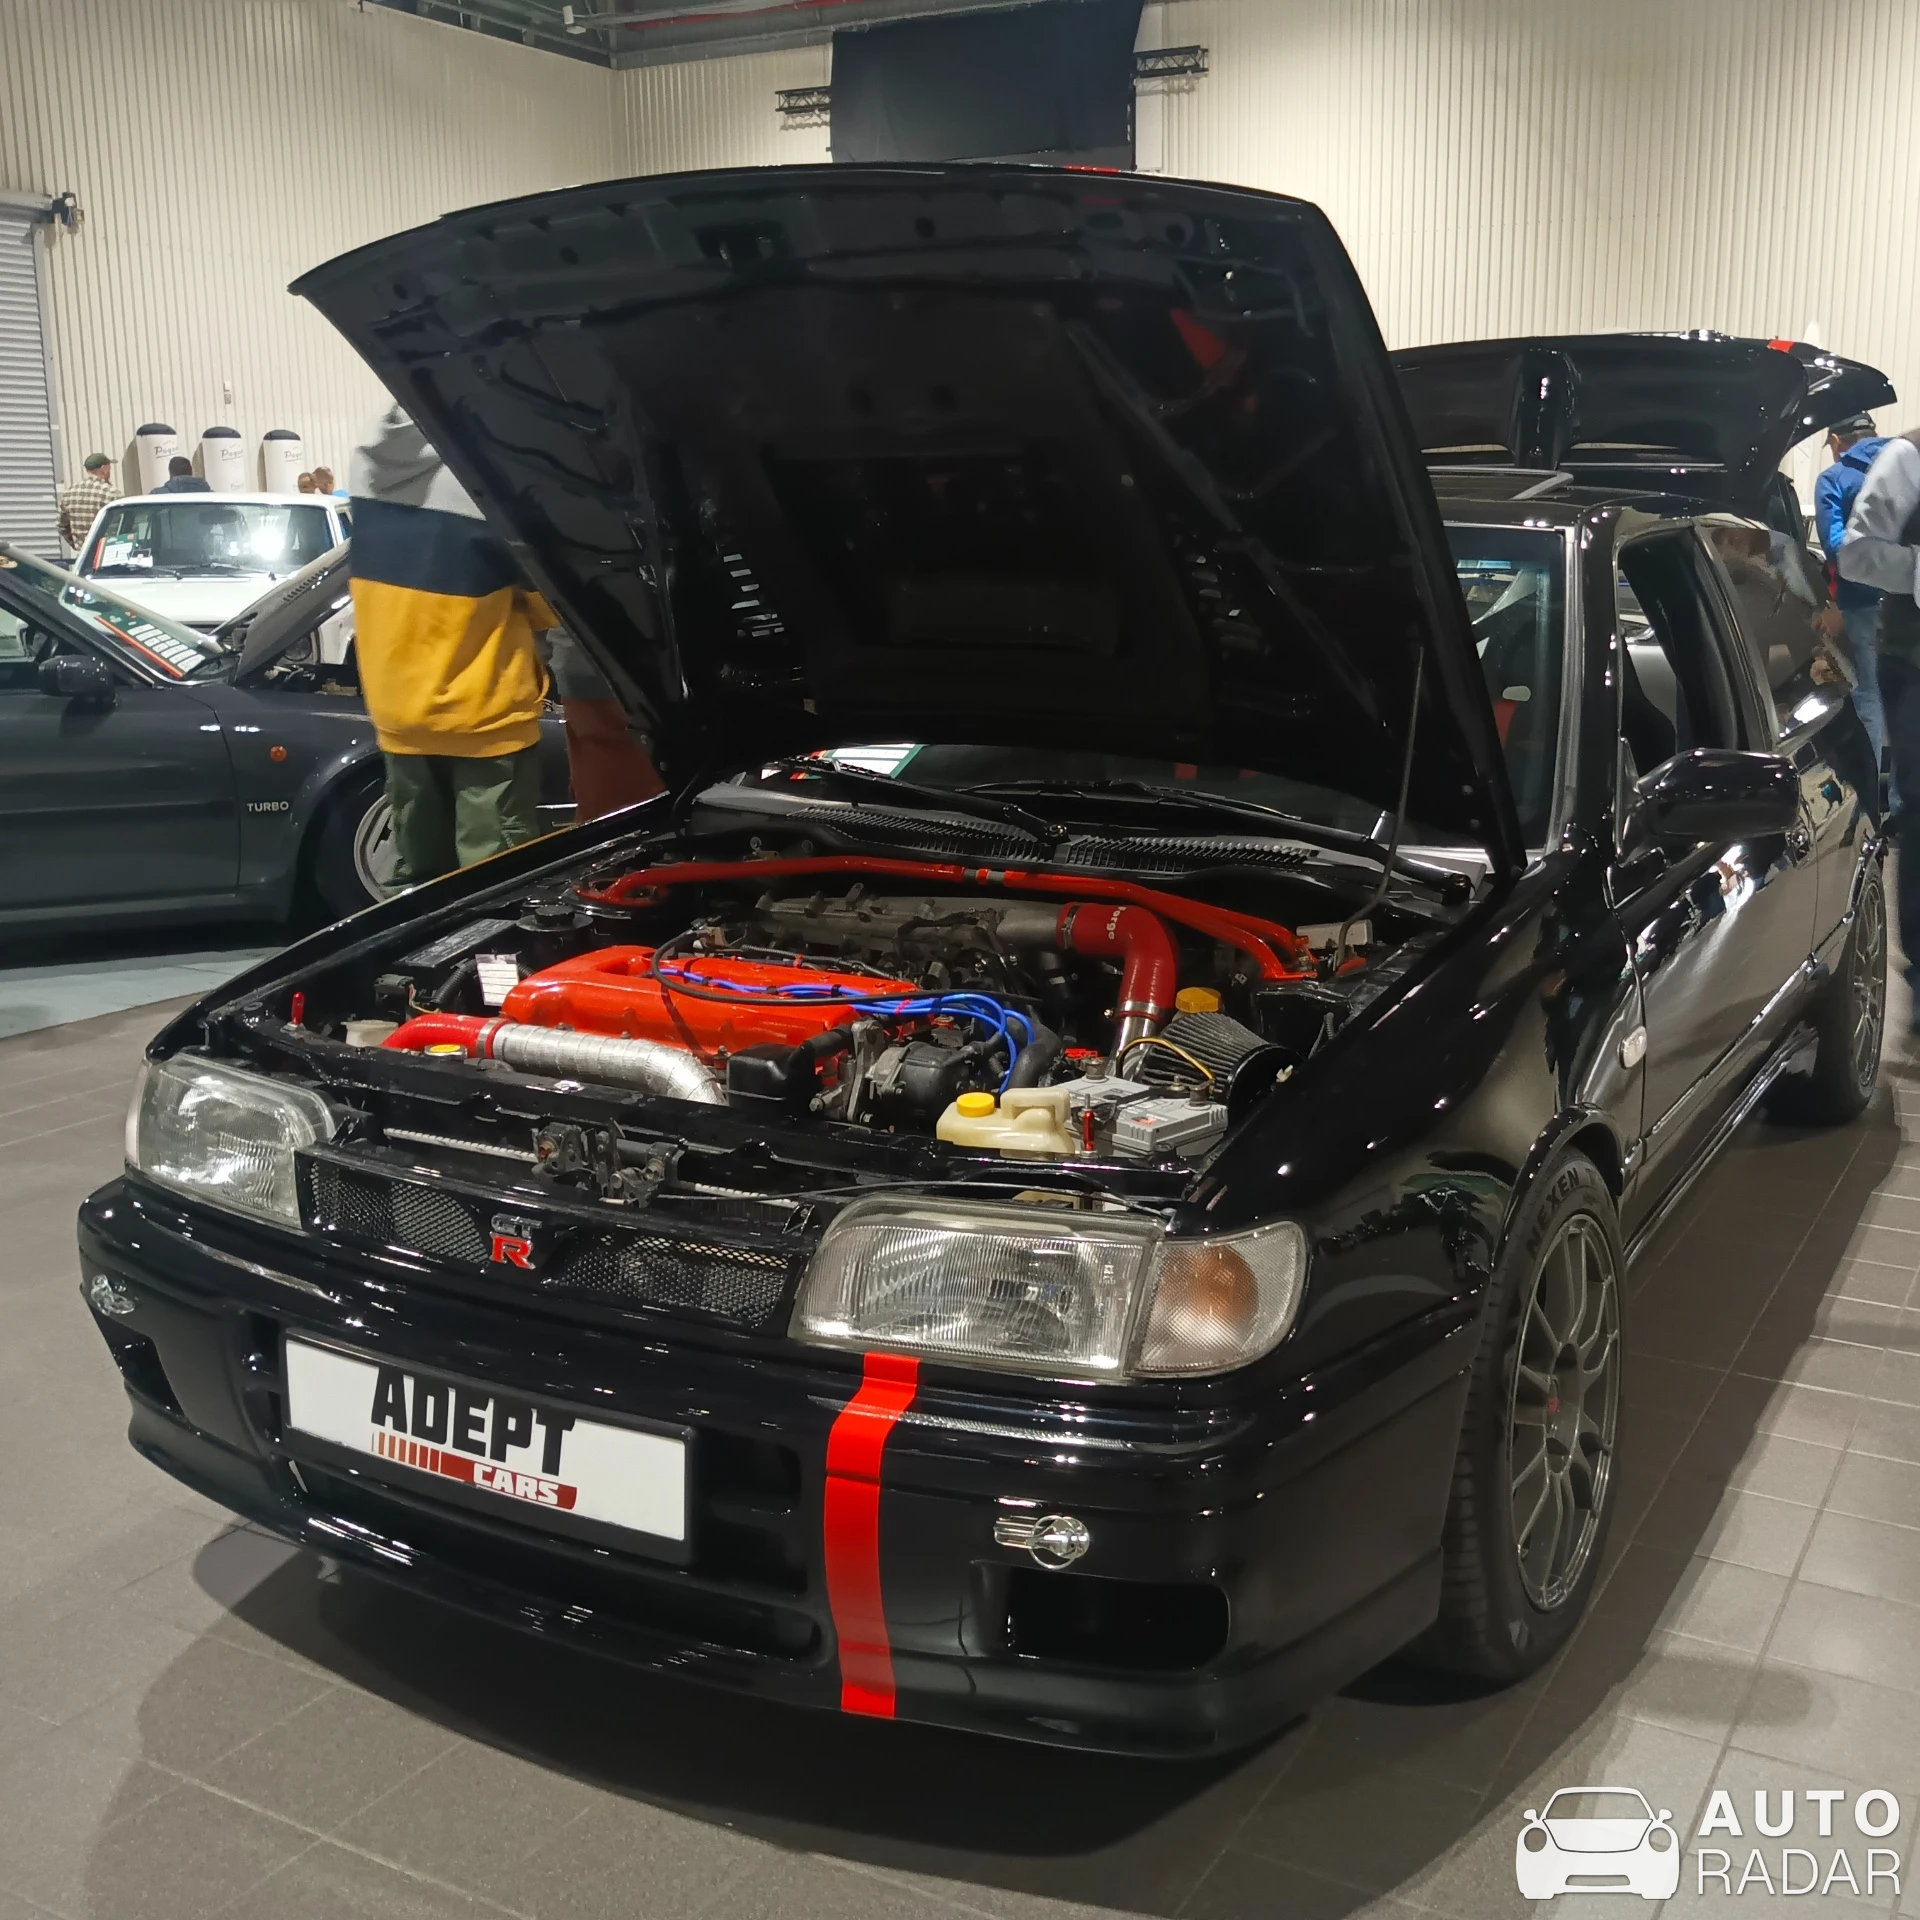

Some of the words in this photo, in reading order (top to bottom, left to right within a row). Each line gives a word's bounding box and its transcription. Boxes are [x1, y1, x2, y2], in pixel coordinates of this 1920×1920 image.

[247, 801, 289, 812] TURBO
[1526, 1167, 1581, 1259] NEXEN
[371, 1364, 576, 1477] ADEPT
[473, 1462, 559, 1506] CARS
